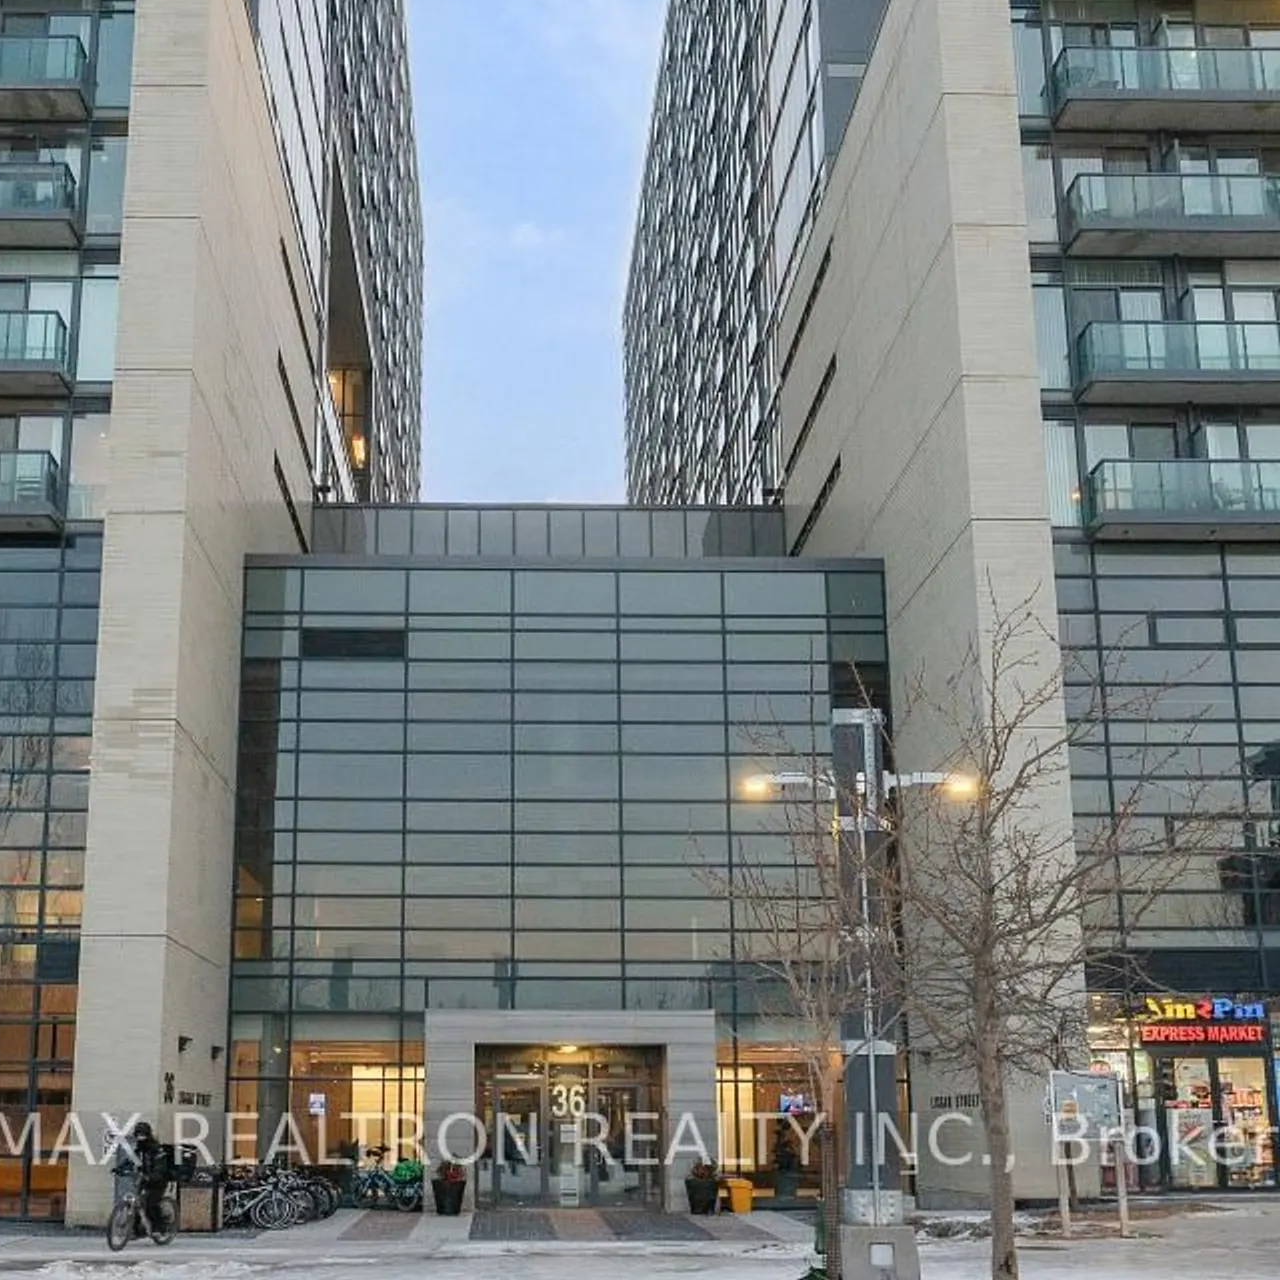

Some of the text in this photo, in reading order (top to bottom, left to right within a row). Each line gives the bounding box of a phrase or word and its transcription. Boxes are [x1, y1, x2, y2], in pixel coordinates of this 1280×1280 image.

[1141, 1026, 1263, 1043] EXPRESS MARKET
[552, 1084, 586, 1118] 36
